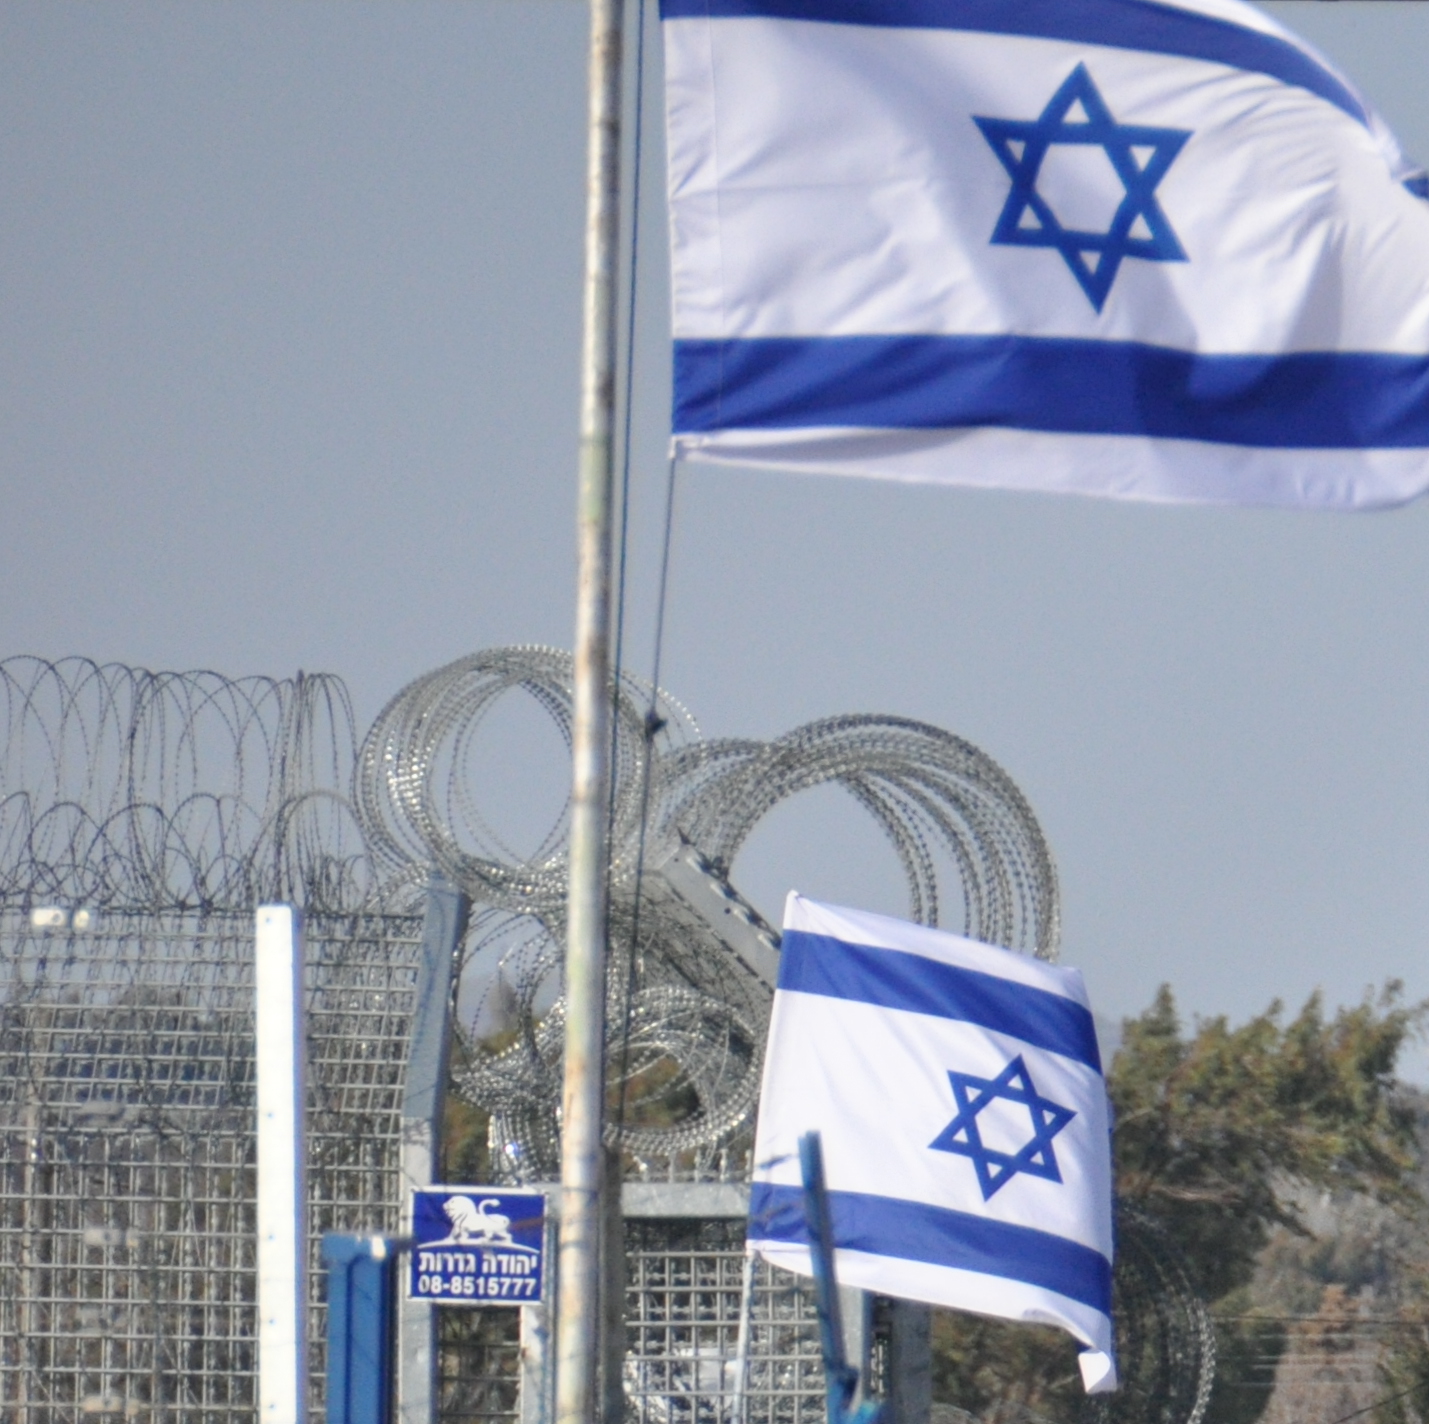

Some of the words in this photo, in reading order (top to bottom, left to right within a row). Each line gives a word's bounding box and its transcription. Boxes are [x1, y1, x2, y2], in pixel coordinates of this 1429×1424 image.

[418, 1251, 476, 1273] גדרות
[482, 1253, 538, 1275] יהודה
[418, 1275, 537, 1296] 08-8515777
